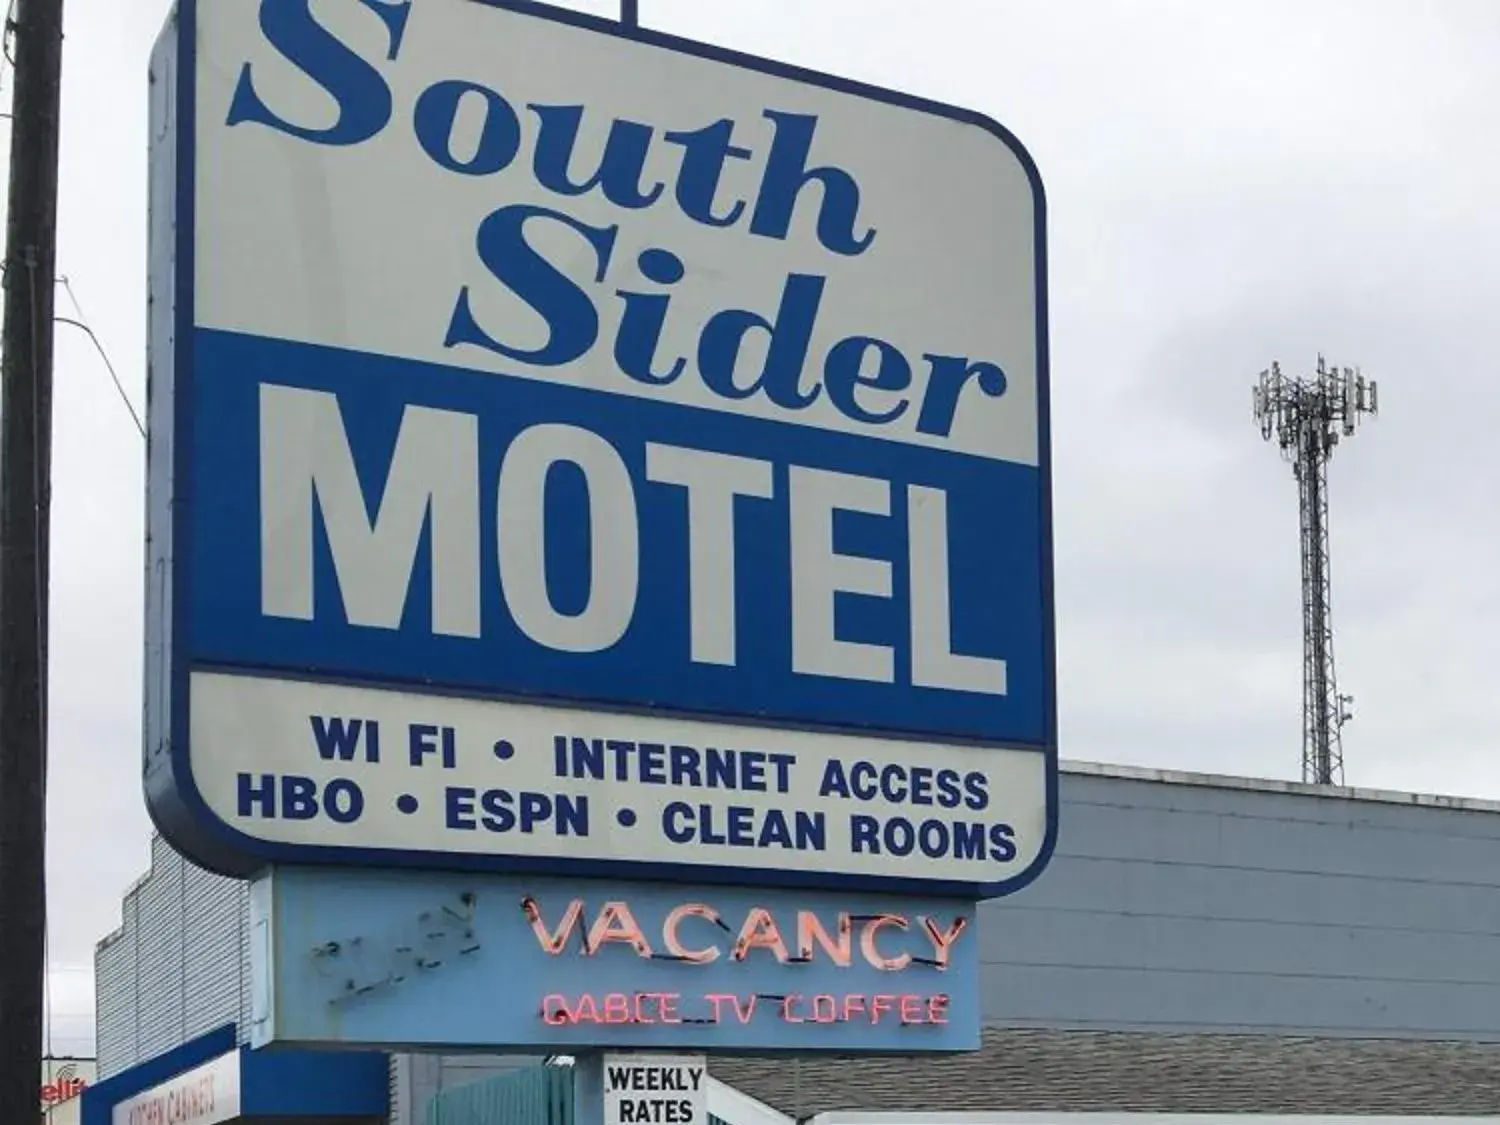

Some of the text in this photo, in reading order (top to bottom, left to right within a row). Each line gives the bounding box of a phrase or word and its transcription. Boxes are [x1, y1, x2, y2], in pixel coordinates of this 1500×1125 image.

[226, 0, 877, 256] South
[443, 203, 1008, 438] Sider
[258, 381, 1007, 695] MOTEL
[310, 715, 990, 811] WI FI INTERNET ACCESS
[235, 773, 1017, 863] HBO ESPN CLEAN ROOMS
[521, 897, 967, 972] VACANCY
[704, 993, 758, 1024] TV
[782, 993, 950, 1026] COFFEE
[608, 1066, 704, 1123] WEEKLY RATES
